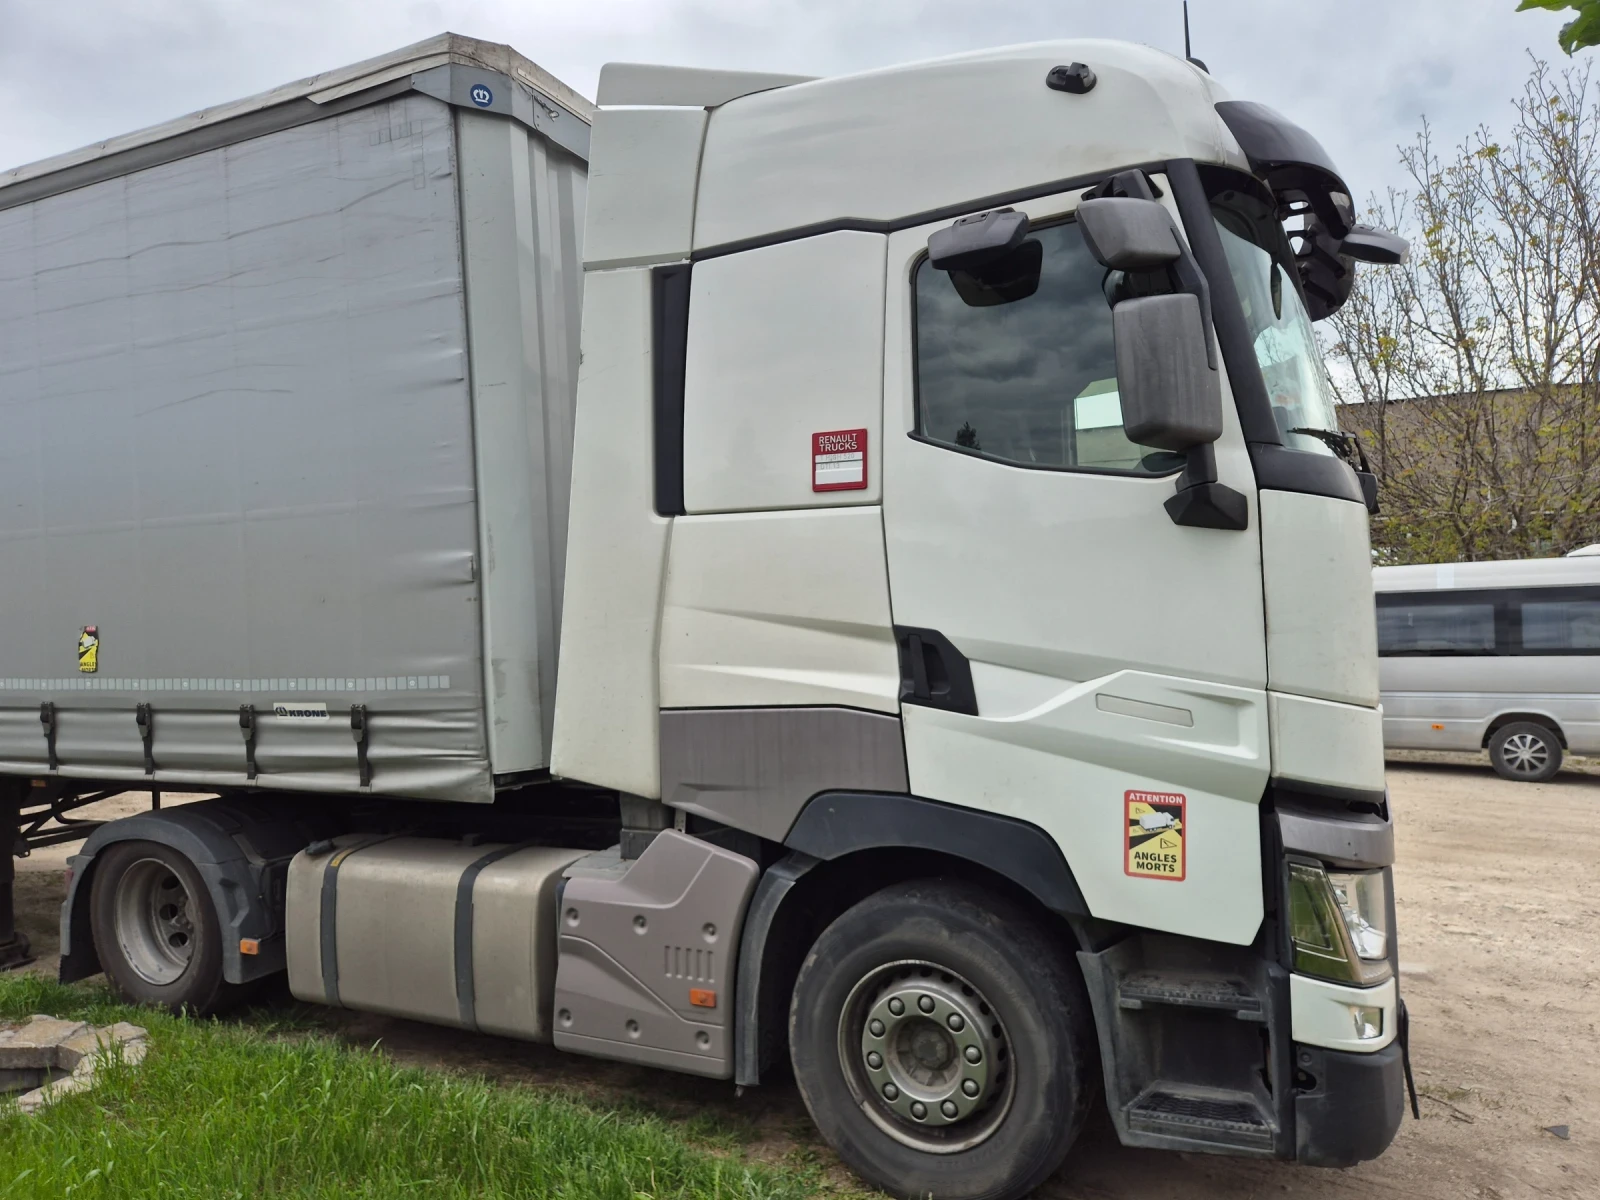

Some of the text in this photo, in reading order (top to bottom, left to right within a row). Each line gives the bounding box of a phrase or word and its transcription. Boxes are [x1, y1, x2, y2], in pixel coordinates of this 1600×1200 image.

[819, 433, 857, 444] RENAULT
[819, 441, 857, 452] TRUCKS
[1129, 792, 1183, 804] ATTENTION
[1134, 851, 1177, 863] ANGLES
[1136, 861, 1175, 872] MORTS
